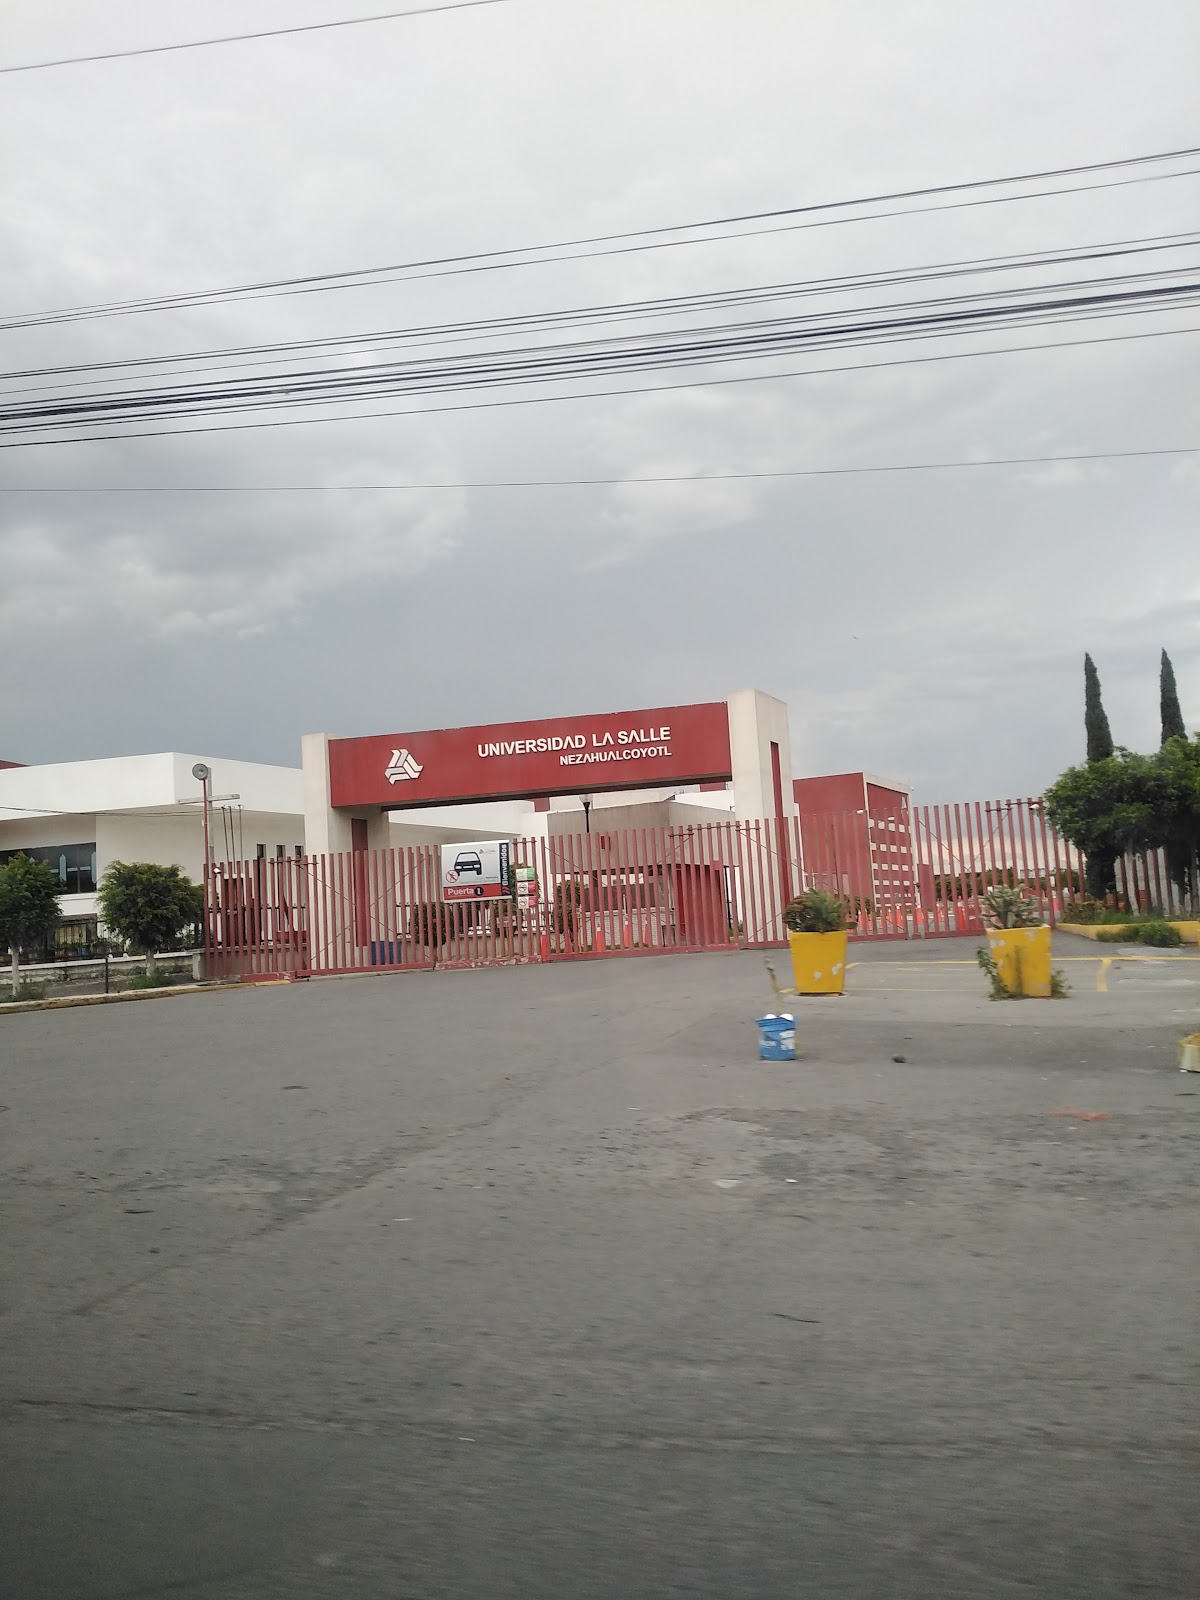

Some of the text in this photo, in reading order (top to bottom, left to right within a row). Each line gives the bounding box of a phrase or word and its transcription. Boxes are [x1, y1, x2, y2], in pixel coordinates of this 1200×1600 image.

[477, 726, 671, 758] UNIVERSIDAD LA SALLE
[559, 746, 672, 766] NEZAHUALCOYOTL
[447, 887, 474, 896] Puerta
